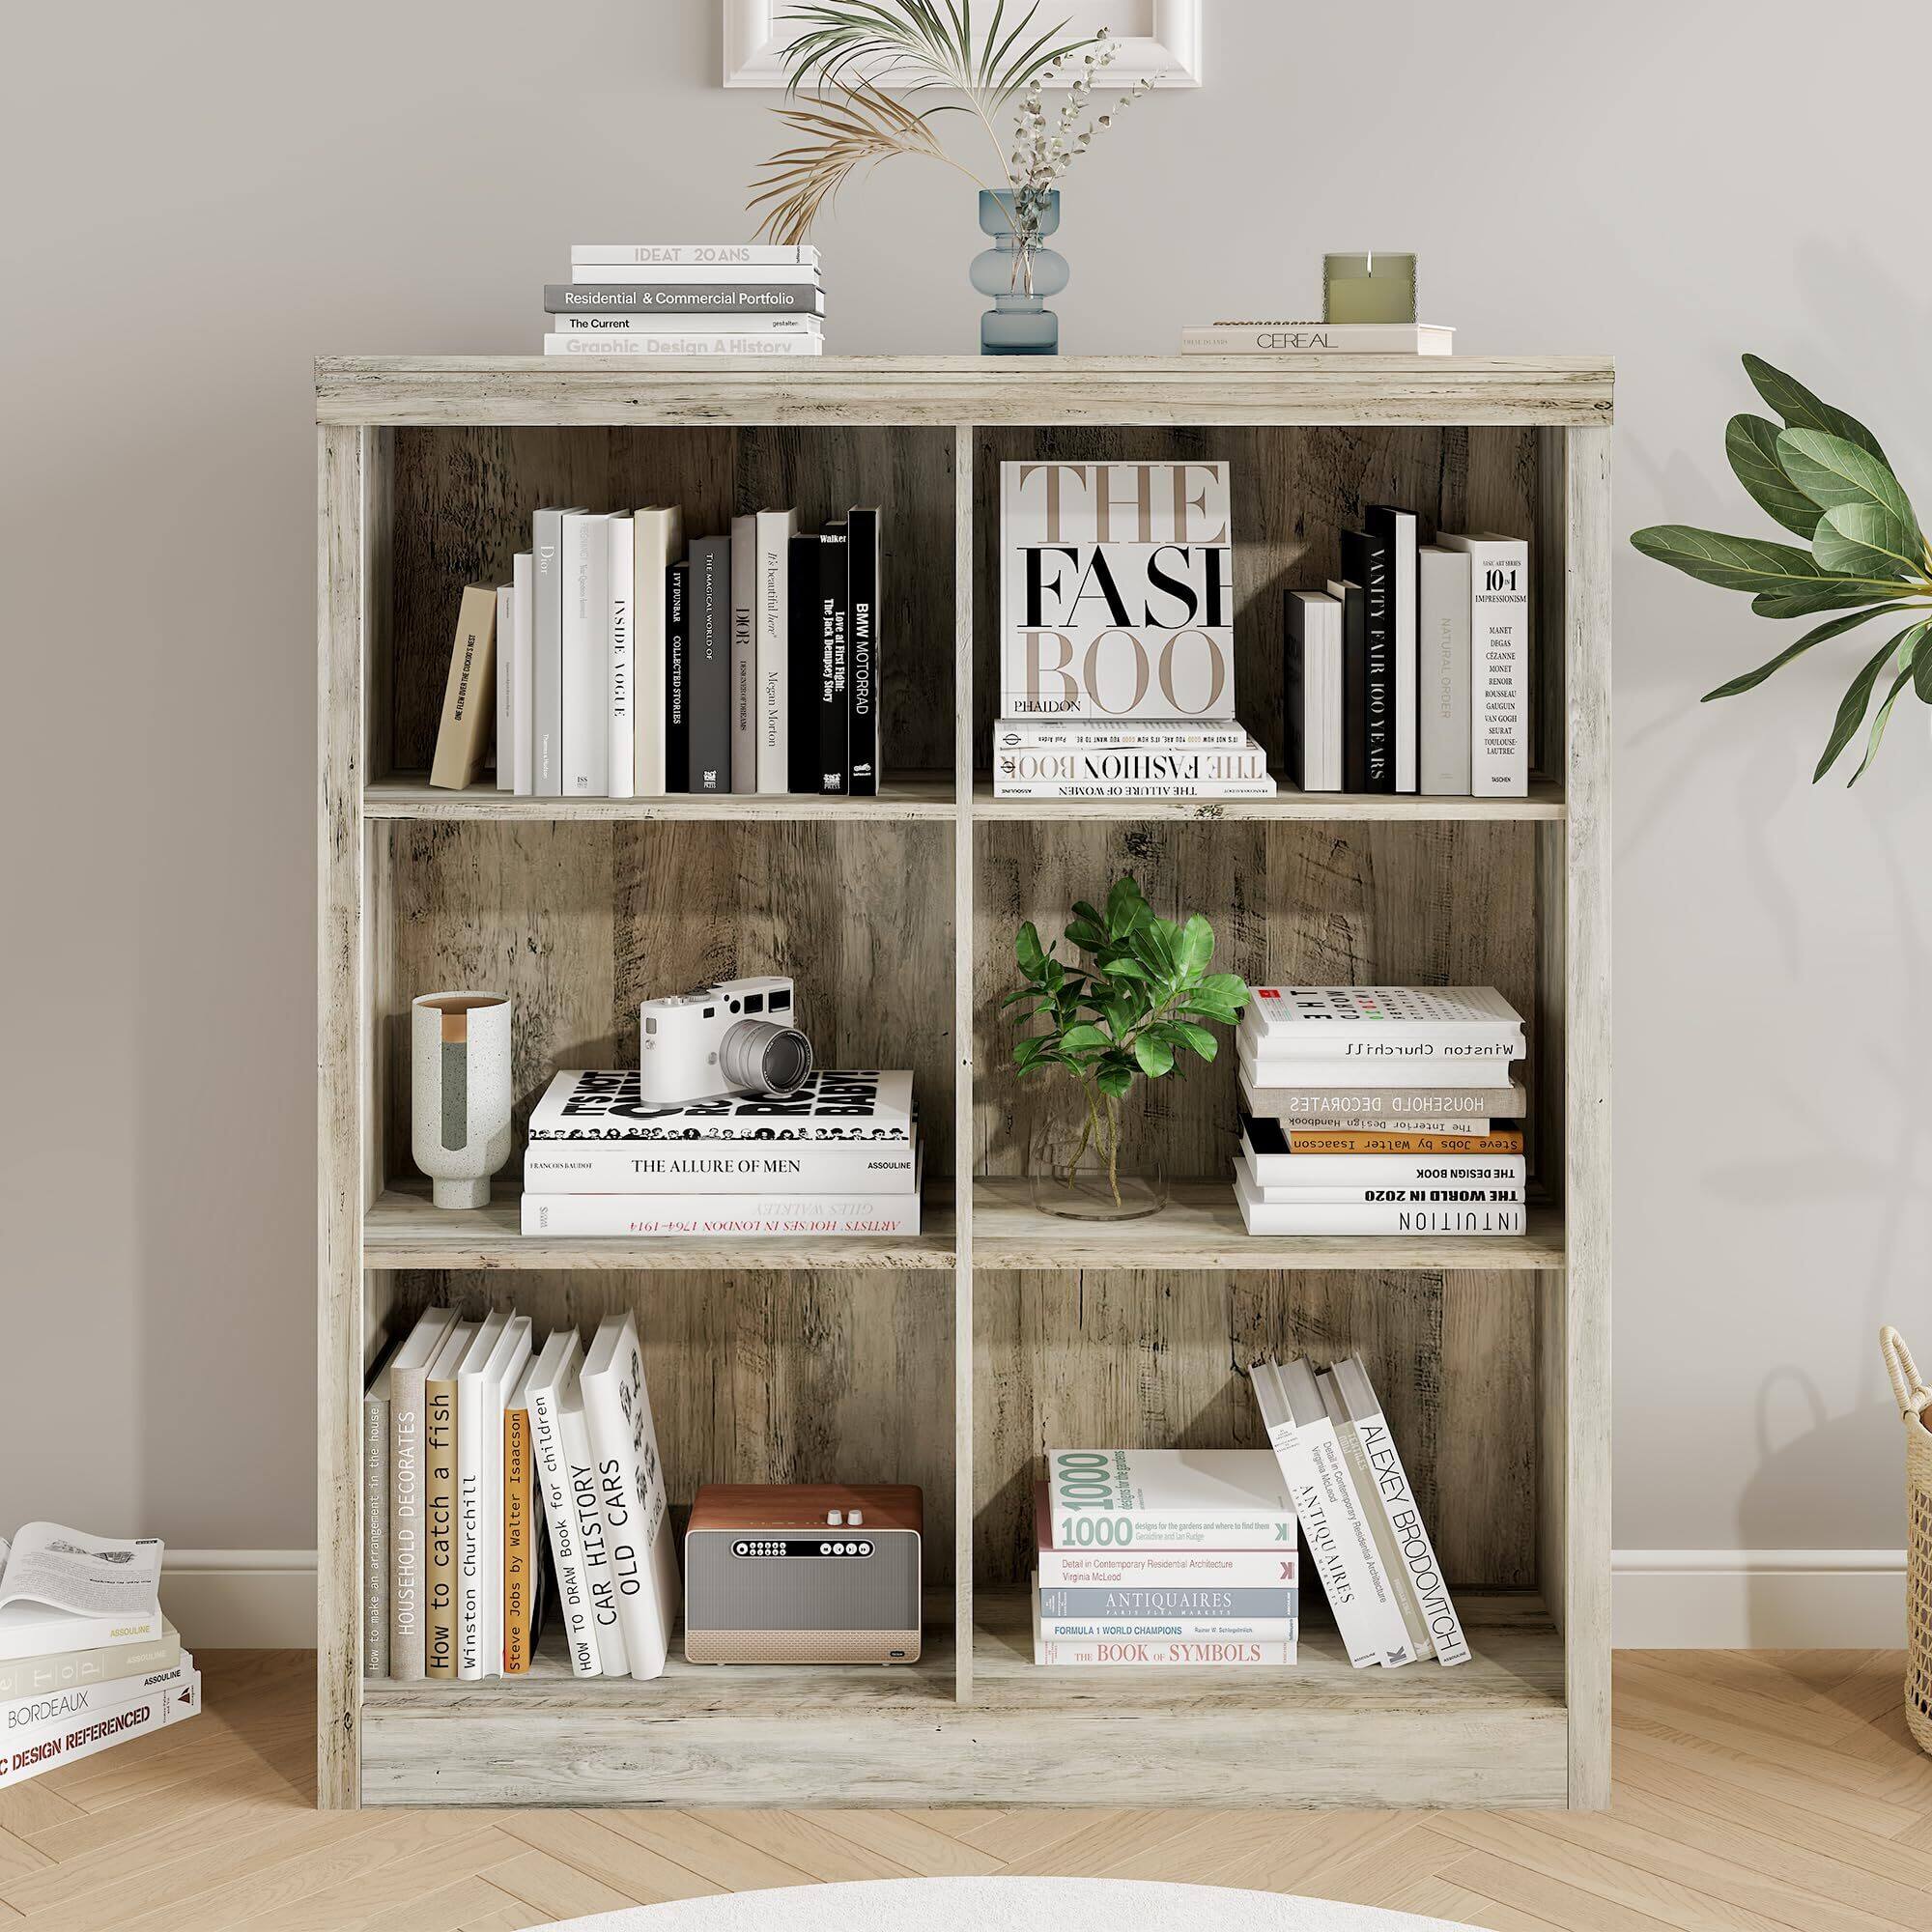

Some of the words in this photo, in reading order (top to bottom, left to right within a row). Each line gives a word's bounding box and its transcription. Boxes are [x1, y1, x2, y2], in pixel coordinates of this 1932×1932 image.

[635, 248, 682, 262] IDEAT
[694, 248, 716, 262] 20
[718, 248, 750, 262] ANS
[565, 293, 637, 304] Residential
[643, 294, 652, 304] &
[656, 293, 735, 304] Commercial
[739, 293, 794, 305] Portfolio
[570, 319, 588, 328] The
[590, 319, 630, 328] Current
[566, 339, 639, 354] Graphic
[647, 339, 708, 354] Design
[713, 340, 725, 353] A
[729, 339, 792, 354] History
[1257, 333, 1339, 349] CEREAL
[1020, 465, 1226, 544] THE
[820, 534, 846, 543] Walker
[540, 546, 554, 575] Dior
[1371, 549, 1385, 620] VANITY
[824, 598, 834, 615] The
[614, 600, 625, 654] INSIDE
[736, 609, 750, 644] DIOR
[823, 616, 834, 637] Jack
[835, 611, 845, 632] Love
[856, 603, 868, 638] BMW
[835, 635, 845, 643] at
[705, 648, 713, 661] OF
[823, 639, 834, 678] Dempsey
[835, 645, 845, 664] First
[1371, 630, 1385, 673] FAIR
[1486, 651, 1516, 660] CÉZANNE
[766, 671, 778, 706] Megan
[834, 667, 845, 692] Fight:
[856, 641, 868, 714] MOTORRAD
[614, 663, 625, 717] VOGUE
[823, 680, 834, 702] Story
[1014, 700, 1081, 713] PHAIDON
[768, 709, 778, 747] Morton
[1371, 720, 1385, 780] YEARS
[1084, 755, 1199, 779] FASHION
[1208, 755, 1263, 779] THE
[1059, 786, 1104, 796] WOMEN
[1105, 786, 1120, 796] OF
[1122, 786, 1171, 796] ALLURE
[1173, 786, 1198, 796] THE
[573, 1071, 625, 1094] NOT
[814, 1071, 880, 1116] BABY!
[1293, 1140, 1355, 1150] Isaacson
[1364, 1140, 1410, 1150] Walter
[1418, 1138, 1433, 1151] by
[1441, 1140, 1471, 1150] Jobs
[1479, 1140, 1518, 1150] Steve
[632, 1159, 667, 1173] THE
[670, 1159, 734, 1173] ALLURE
[738, 1159, 760, 1173] OF
[763, 1159, 801, 1173] MEN
[1365, 1191, 1406, 1201] 2020
[1409, 1191, 1425, 1201] IN
[1430, 1191, 1486, 1201] WORLD
[1490, 1191, 1518, 1201] THE
[702, 1220, 760, 1231] LONDON
[765, 1220, 779, 1231] IN
[783, 1220, 837, 1231] HOUSES
[1399, 1212, 1518, 1231] INTUITION
[370, 1407, 379, 1441] house
[429, 1395, 449, 1449] fish
[534, 1397, 557, 1472] children
[370, 1449, 379, 1467] the
[509, 1413, 521, 1484] Isaacson
[398, 1411, 415, 1516] DECORATES
[435, 1467, 449, 1479] a
[370, 1475, 379, 1488] in
[599, 1459, 628, 1526] CARS
[1057, 1453, 1114, 1511] 1000
[550, 1484, 564, 1510] for
[464, 1474, 476, 1577] Churchill
[509, 1493, 521, 1547] Walter
[571, 1465, 607, 1566] HISTORY
[371, 1496, 382, 1569] arrangement
[429, 1496, 449, 1566] catch
[554, 1520, 571, 1556] Book
[1062, 1517, 1133, 1546] 1000
[1360, 1426, 1409, 1504] ALEXEY
[1393, 1510, 1461, 1651] BRODOVITCH
[1301, 1486, 1354, 1604] ANTIQUAIRES
[509, 1556, 523, 1572] by
[614, 1546, 639, 1595] OLD
[1063, 1560, 1083, 1569] Detail
[1085, 1560, 1093, 1569] in
[1094, 1560, 1145, 1571] Contemporary
[1148, 1560, 1188, 1569] Residential
[1189, 1560, 1233, 1569] Architecture
[372, 1576, 379, 1589] an
[398, 1529, 415, 1634] HOUSEHOLD
[563, 1567, 580, 1605] DRAW
[1063, 1573, 1090, 1582] Virginia
[1092, 1573, 1121, 1581] McLeod
[431, 1583, 449, 1609] to
[509, 1582, 521, 1616] Jobs
[592, 1581, 616, 1625] CAR
[1106, 1593, 1232, 1608] ANTIQUAIRES
[370, 1596, 379, 1623] make
[110, 1625, 150, 1637] ASSOULINE
[464, 1589, 475, 1668] Winston
[572, 1614, 585, 1633] TO
[371, 1630, 379, 1642] to
[431, 1626, 449, 1668] How
[370, 1649, 379, 1670] How
[509, 1627, 521, 1670] Steve
[577, 1642, 592, 1671] HOW
[1074, 1653, 1093, 1662] THE
[1097, 1644, 1150, 1662] BOOK
[1154, 1653, 1166, 1662] OF
[1169, 1644, 1261, 1662] SYMBOLS
[144, 1670, 182, 1686] ASSOULINE
[8, 1690, 89, 1728] BORDEAUX
[13, 1739, 62, 1771] DESIGN
[66, 1706, 150, 1751] REFERENCED
